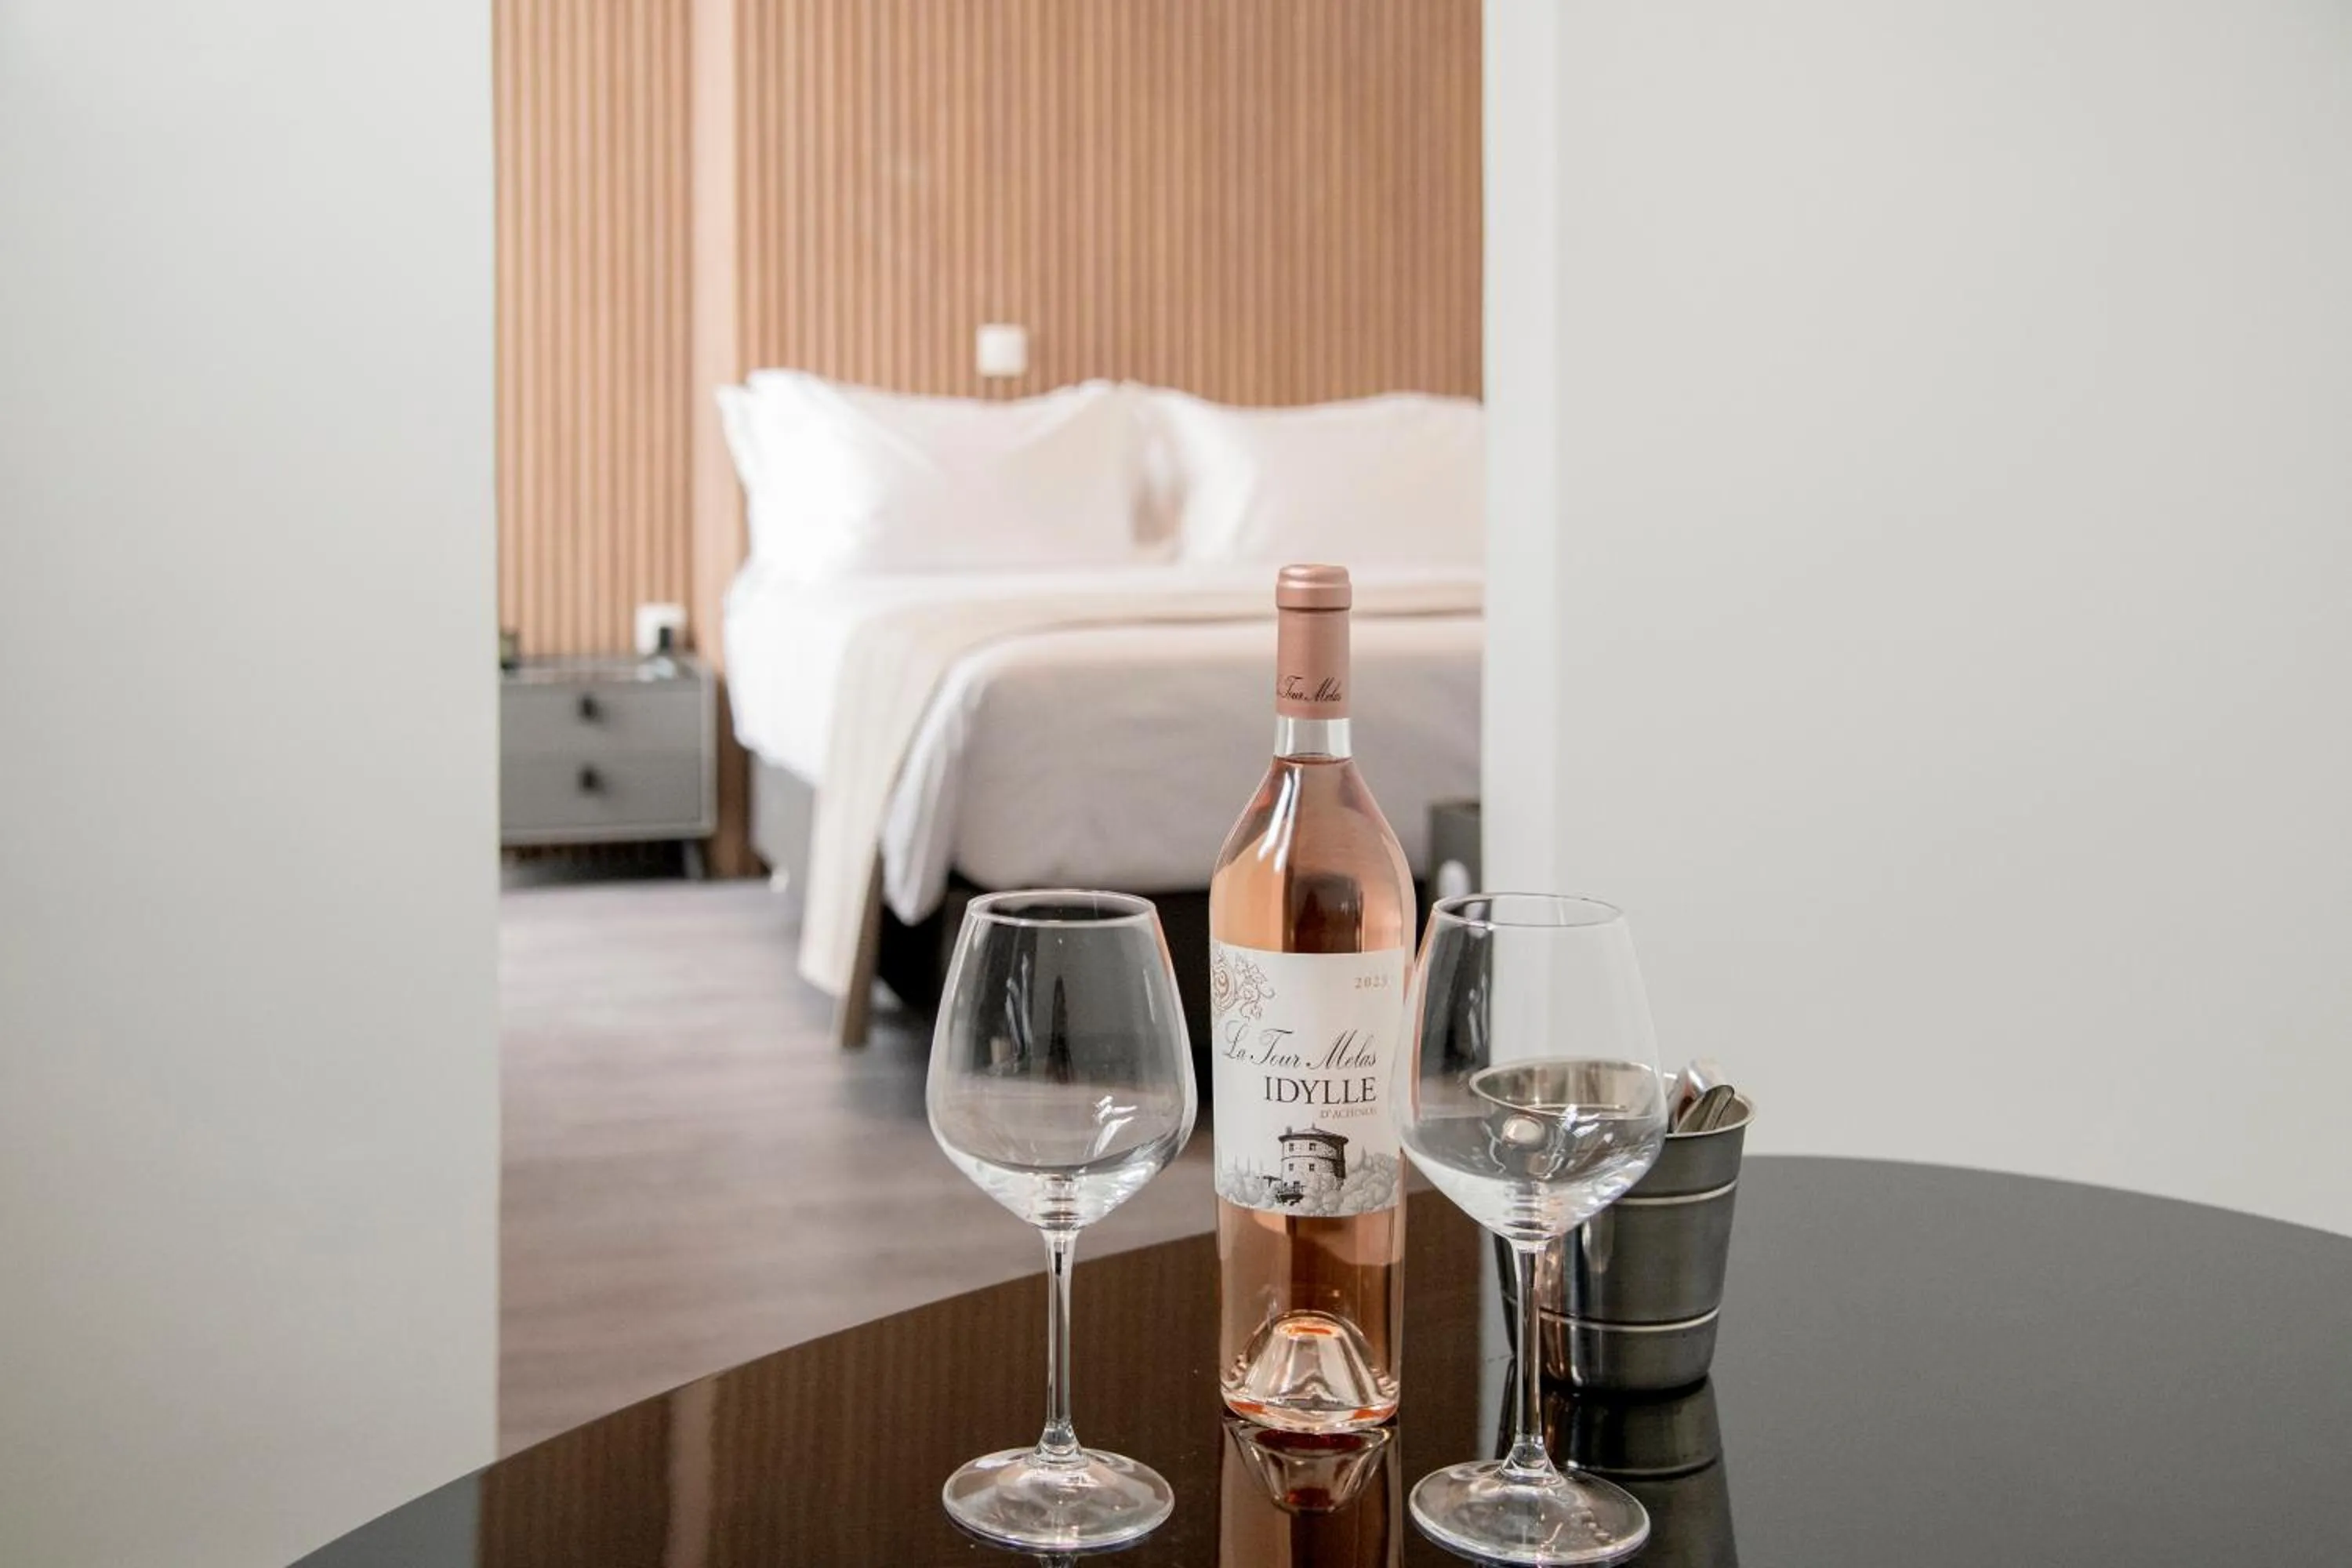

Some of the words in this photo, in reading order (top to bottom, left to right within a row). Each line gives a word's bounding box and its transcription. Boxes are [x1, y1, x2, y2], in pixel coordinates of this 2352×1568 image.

[1222, 1020, 1248, 1060] La
[1250, 1028, 1300, 1069] Tour
[1306, 1029, 1377, 1070] Melas
[1264, 1076, 1377, 1105] IDYLLE
